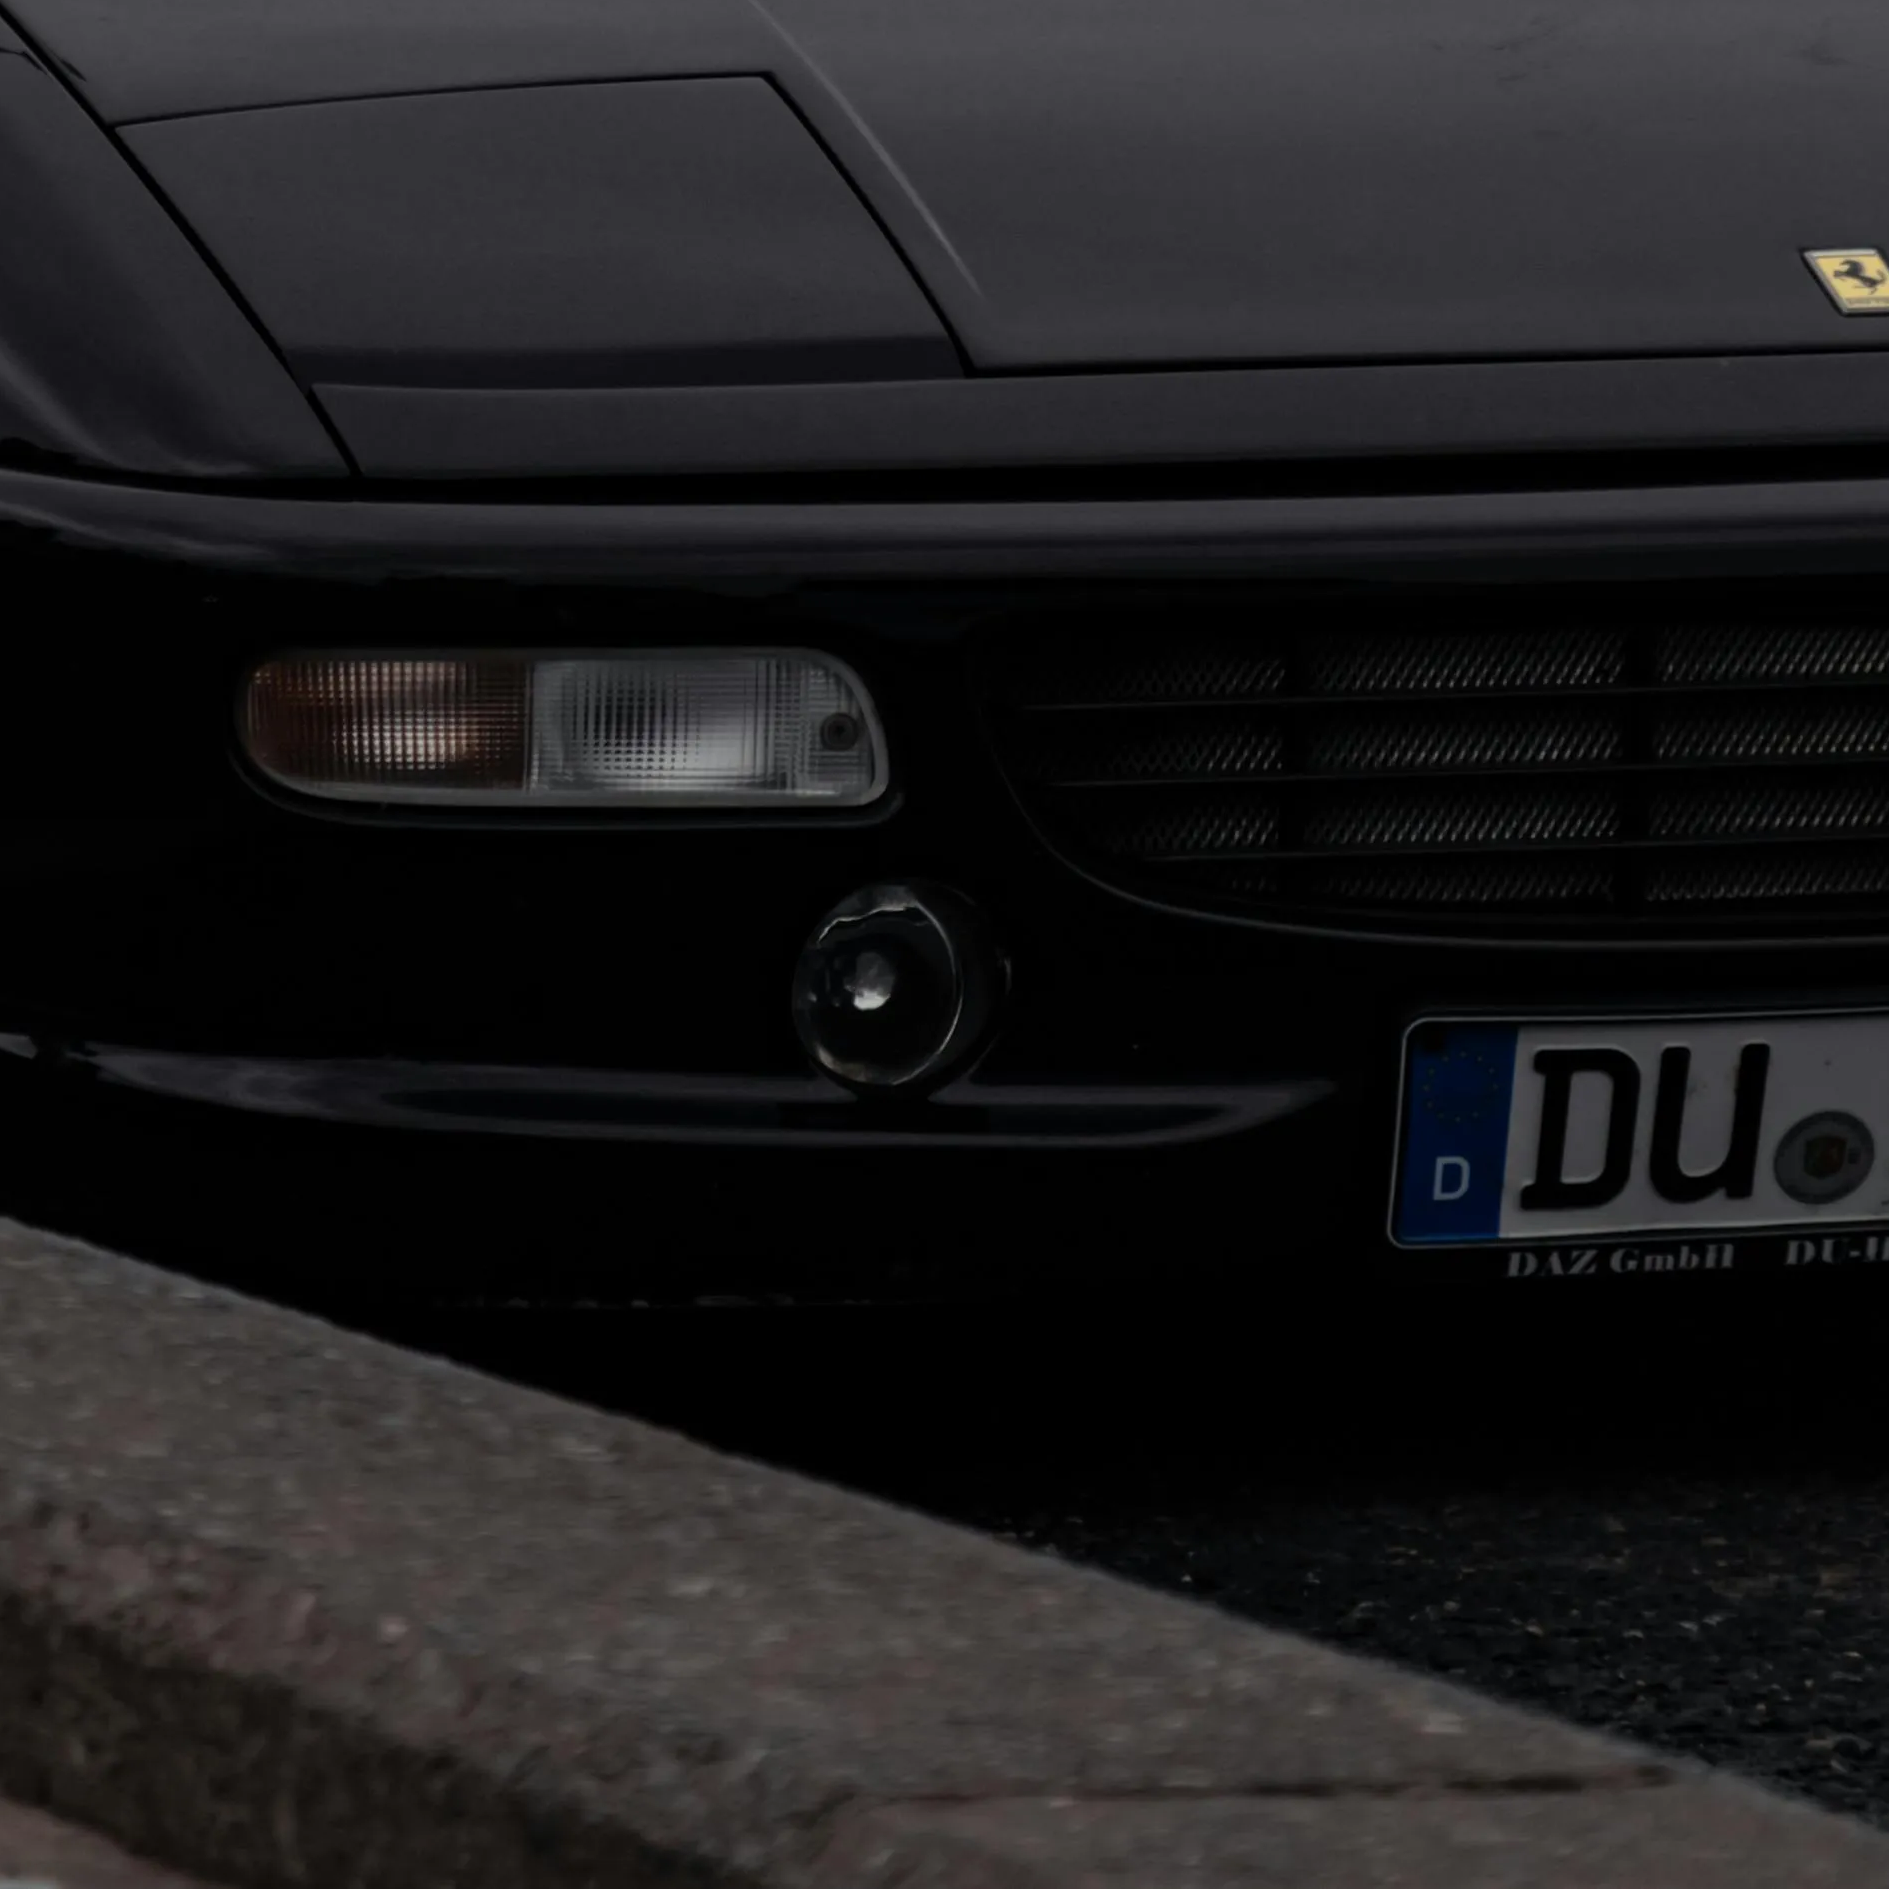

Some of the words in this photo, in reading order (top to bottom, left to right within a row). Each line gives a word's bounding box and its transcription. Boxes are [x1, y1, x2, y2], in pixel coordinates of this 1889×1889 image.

[1521, 1043, 1770, 1211] DU
[1432, 1156, 1471, 1201] D
[1505, 1249, 1599, 1278] DAZ
[1609, 1243, 1735, 1273] GmbH
